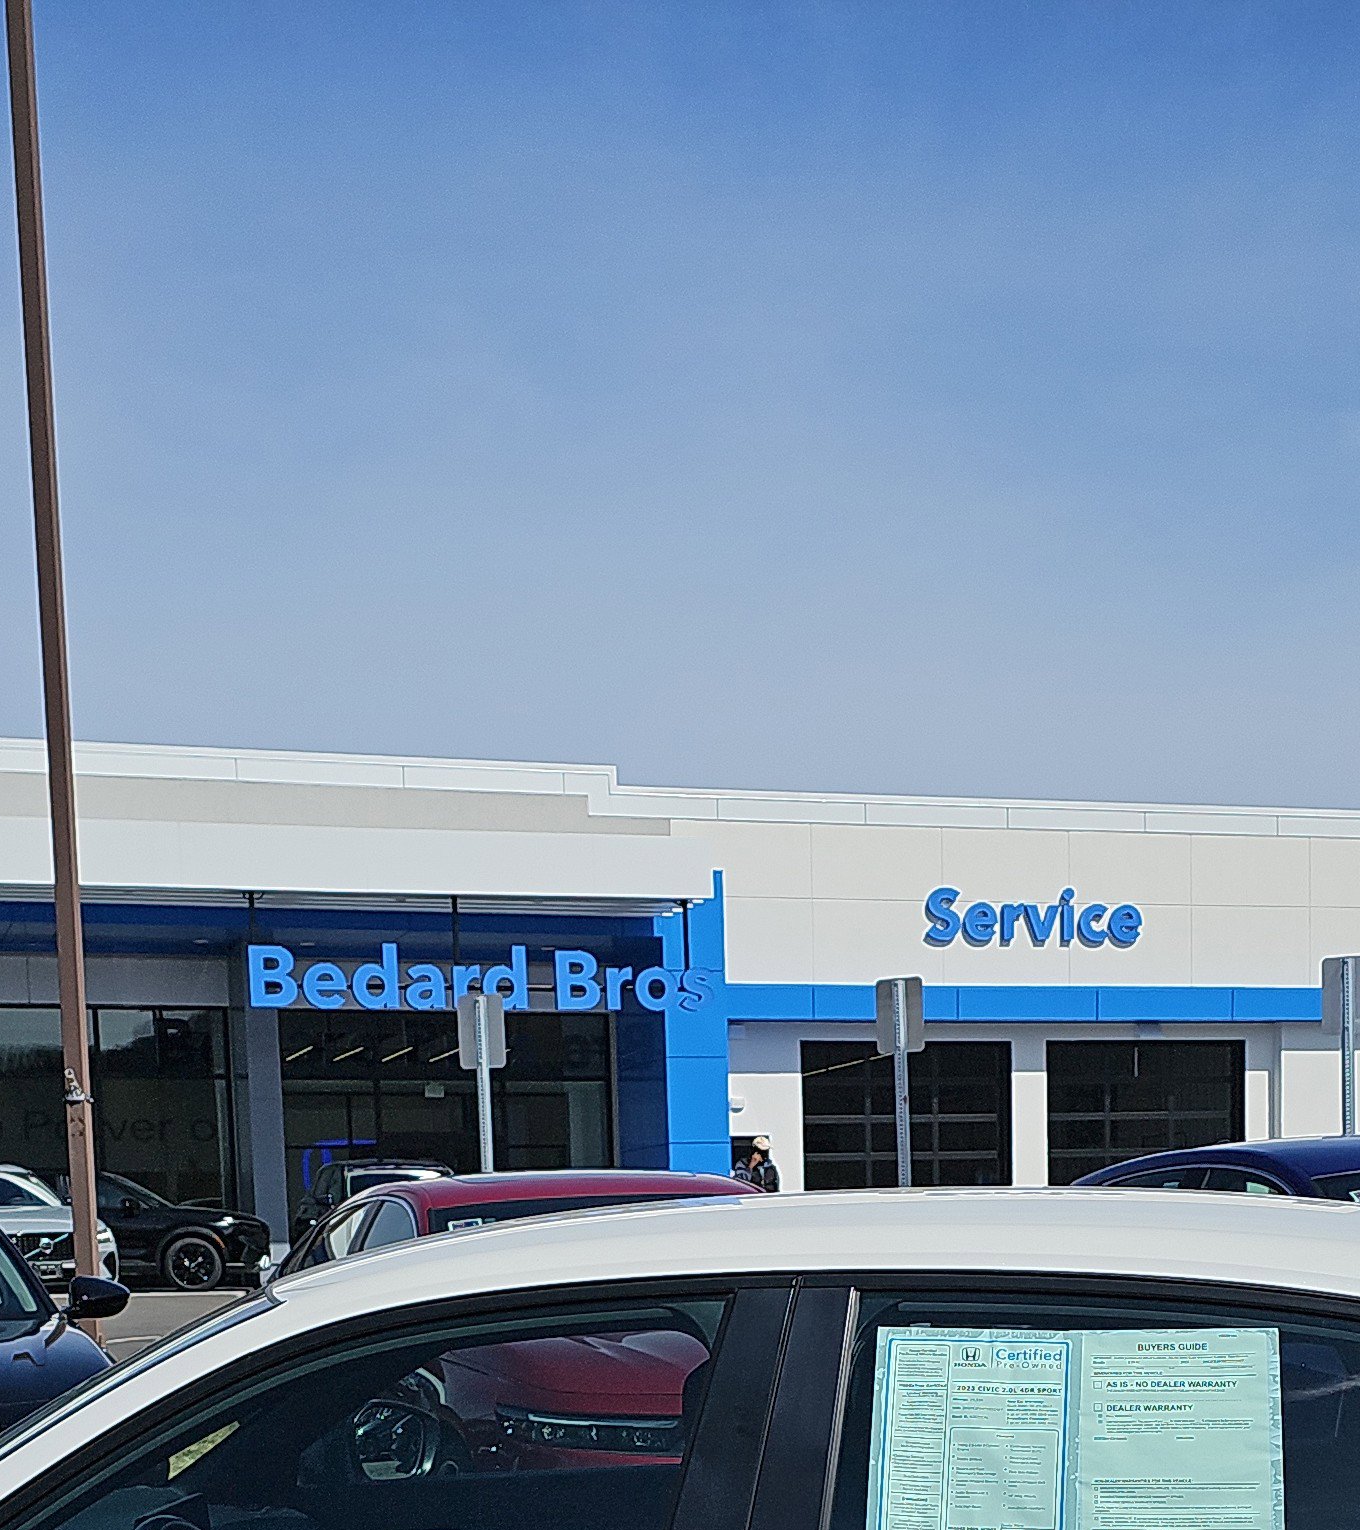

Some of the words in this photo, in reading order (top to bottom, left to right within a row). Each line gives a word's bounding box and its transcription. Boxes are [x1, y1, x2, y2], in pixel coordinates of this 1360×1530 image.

[923, 887, 1143, 949] Service
[247, 943, 529, 1011] Bedard
[554, 950, 715, 1011] Bros
[1137, 1343, 1176, 1352] BUYERS
[1178, 1342, 1208, 1351] GUIDE
[995, 1348, 1062, 1361] Certified
[996, 1361, 1062, 1370] Pre-Owned
[1106, 1404, 1142, 1412] DEALER
